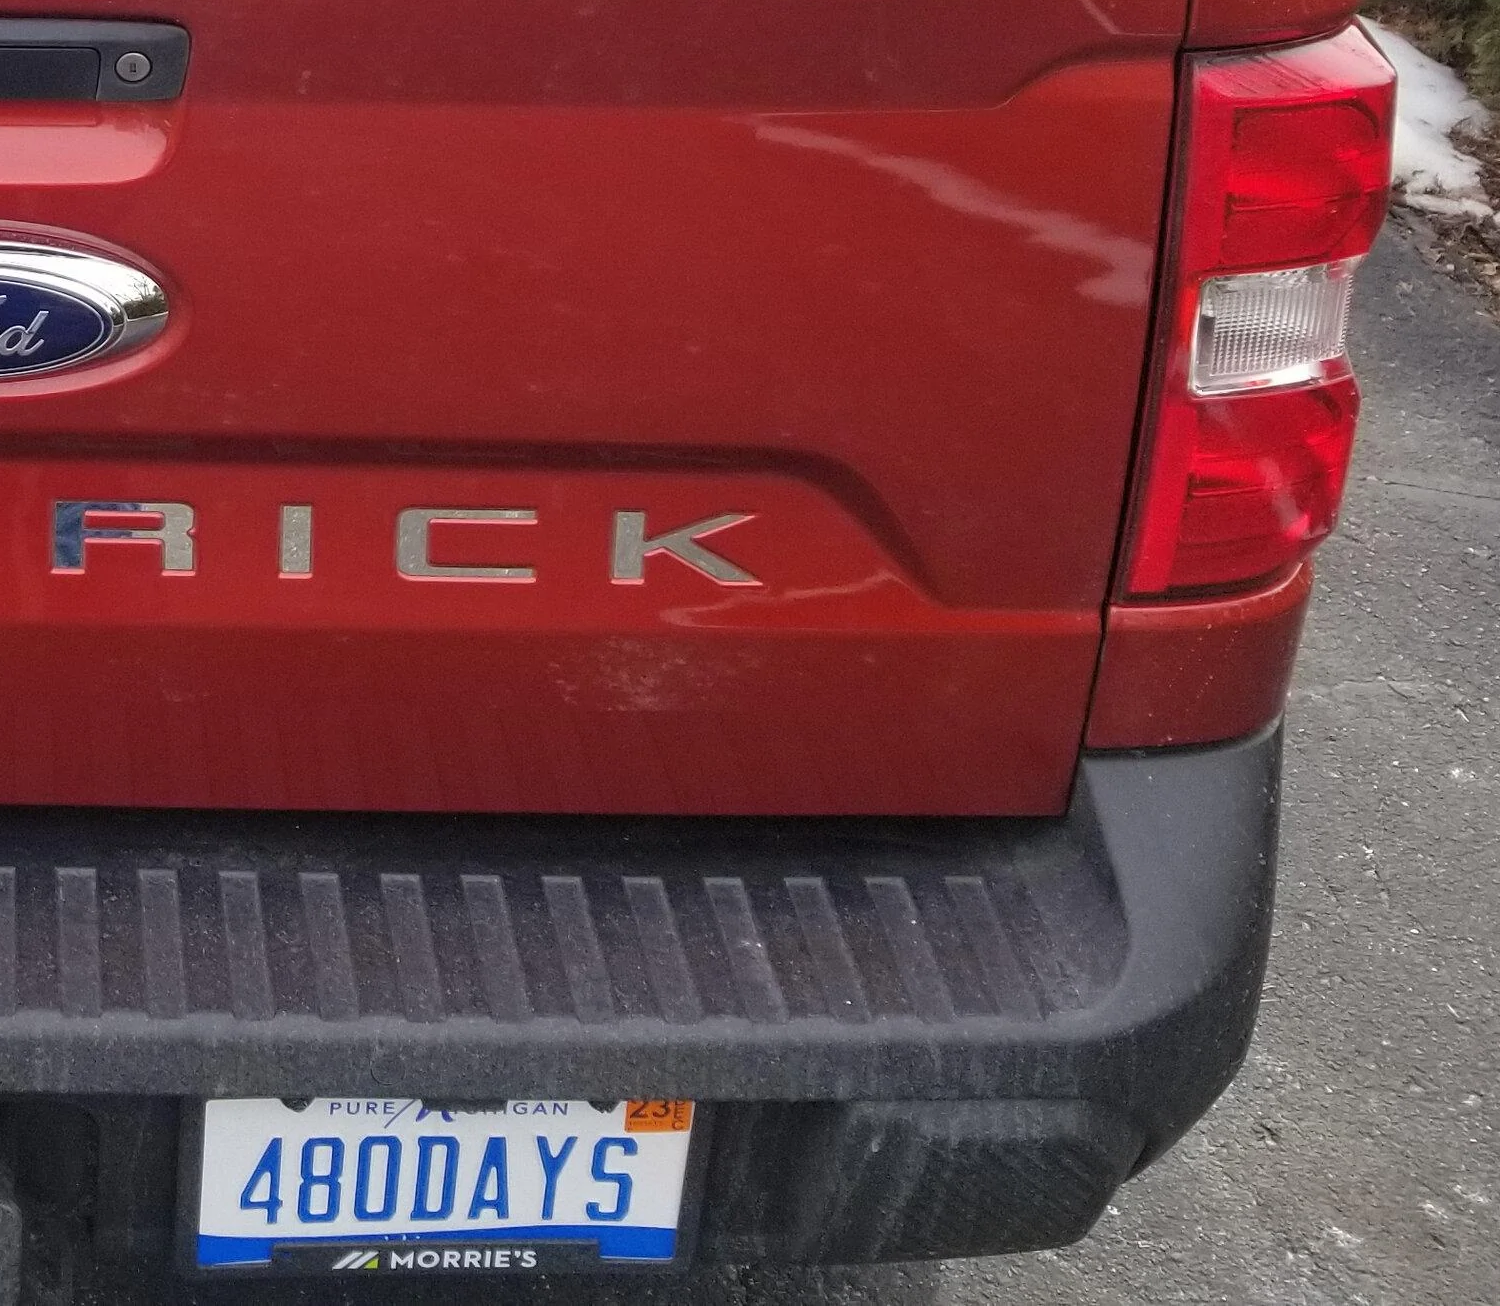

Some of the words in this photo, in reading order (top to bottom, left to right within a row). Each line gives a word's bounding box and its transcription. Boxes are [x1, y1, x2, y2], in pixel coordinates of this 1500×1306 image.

[329, 1101, 395, 1115] PURE
[629, 1099, 671, 1118] 23
[389, 1250, 537, 1269] MORRIE'S
